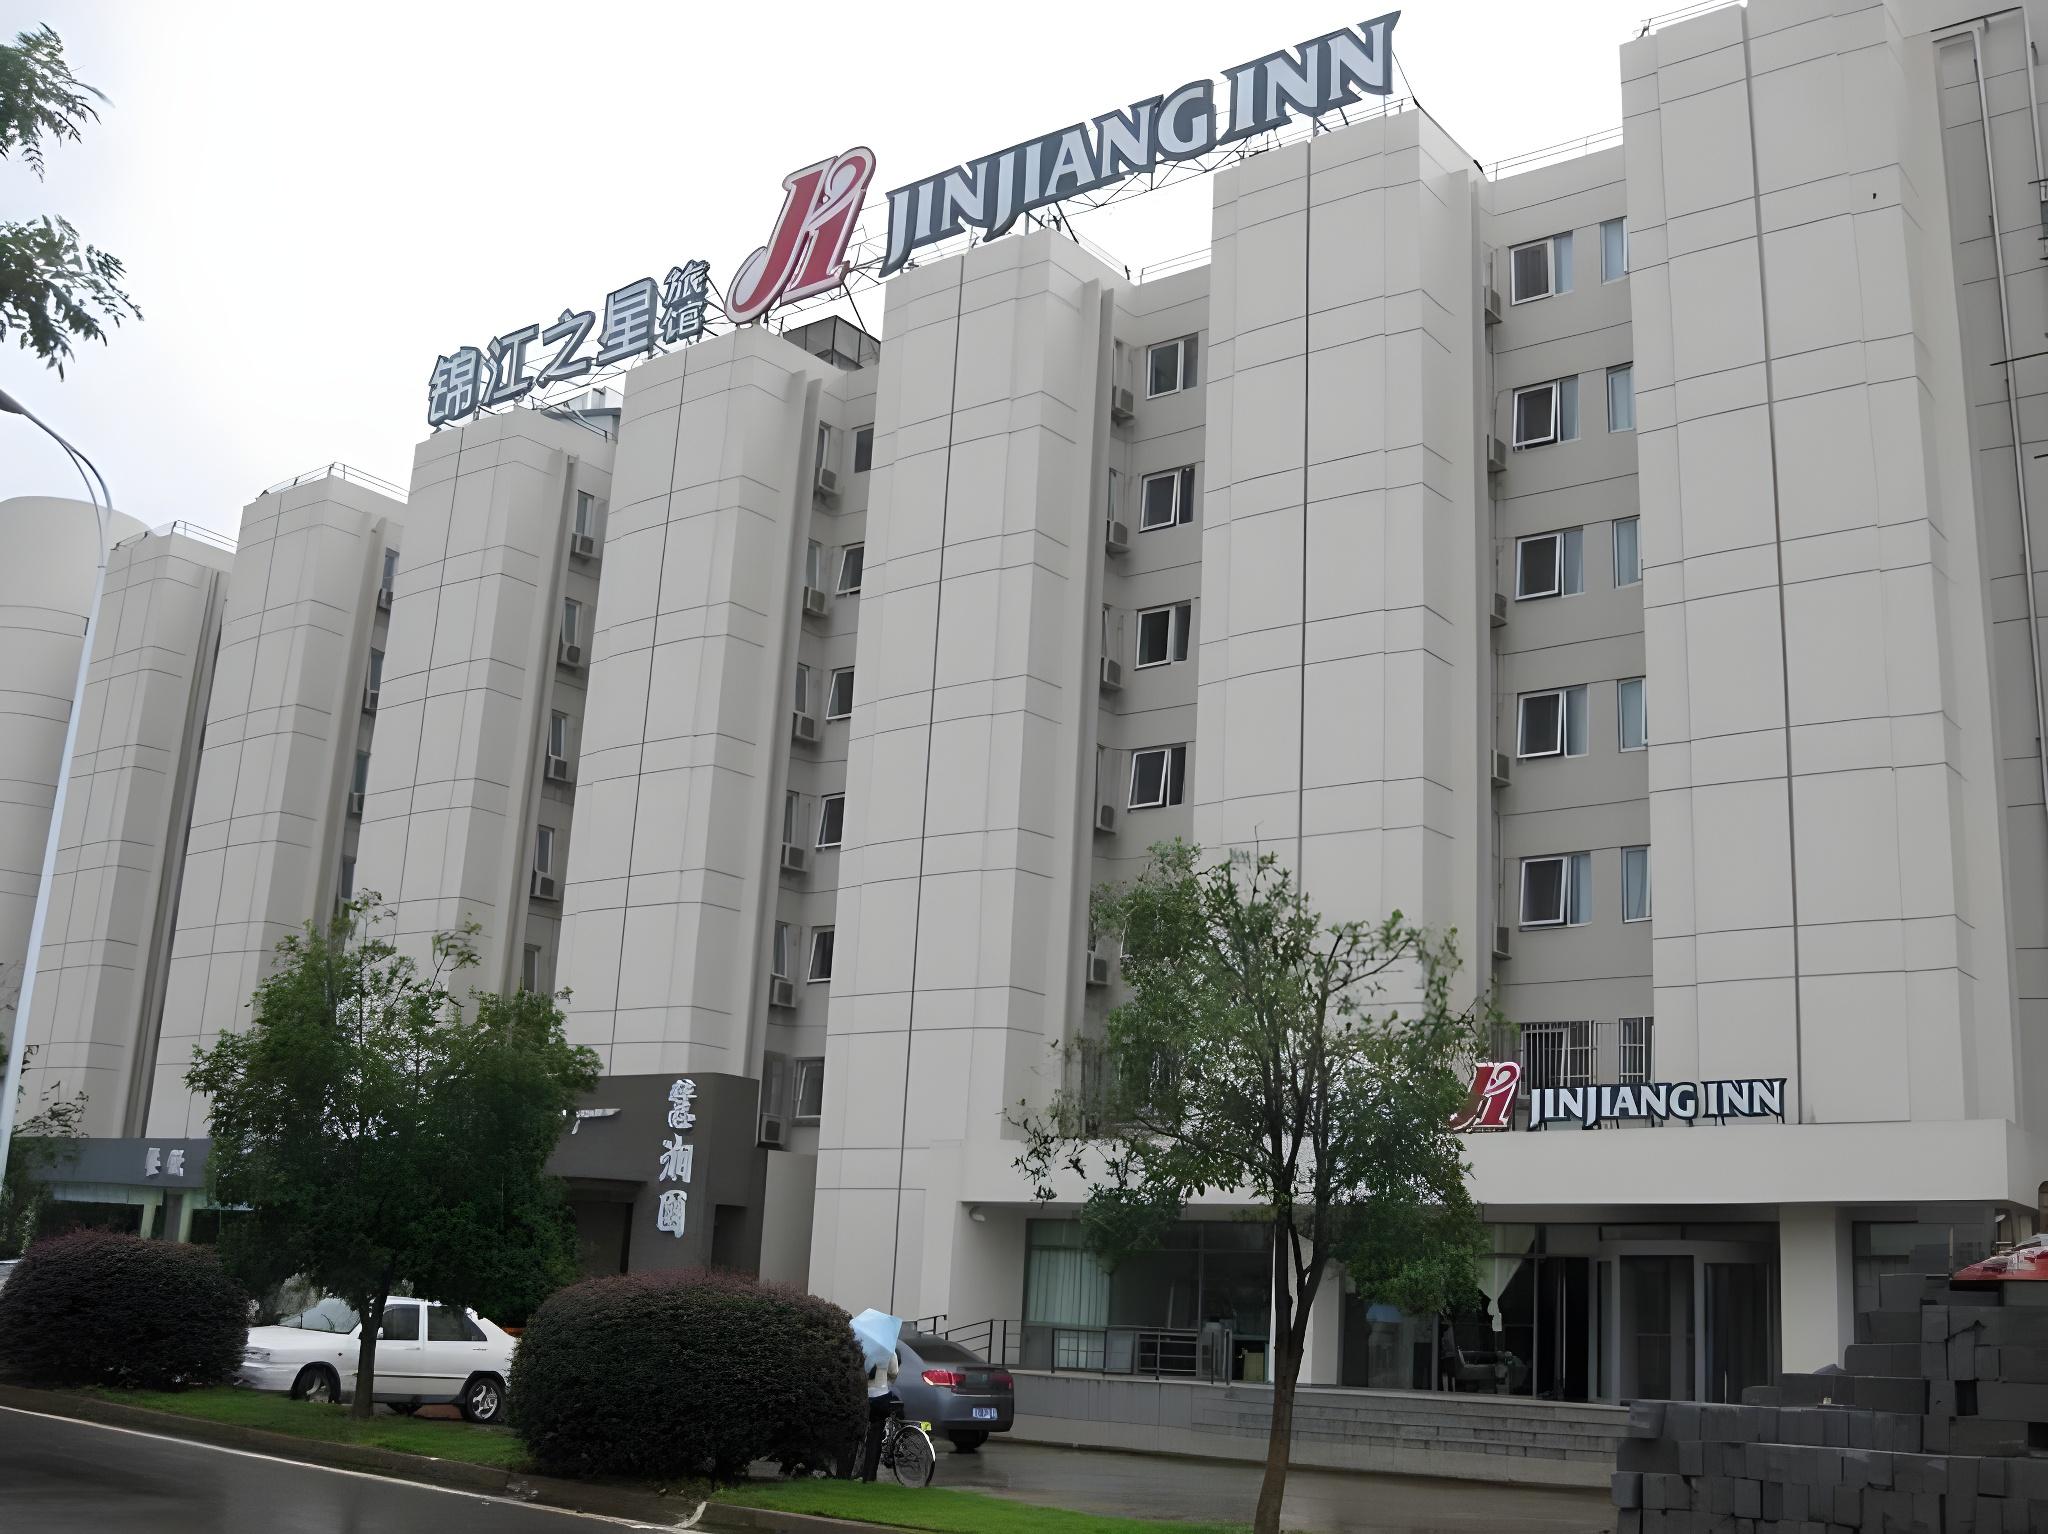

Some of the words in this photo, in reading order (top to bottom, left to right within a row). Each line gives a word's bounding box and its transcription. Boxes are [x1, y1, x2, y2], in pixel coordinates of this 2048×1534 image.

[879, 80, 1216, 276] JINJIANG
[1219, 11, 1401, 145] INN
[428, 277, 658, 427] 锦江之星
[1528, 1082, 1698, 1131] JINJIANG
[1701, 1078, 1787, 1118] INN
